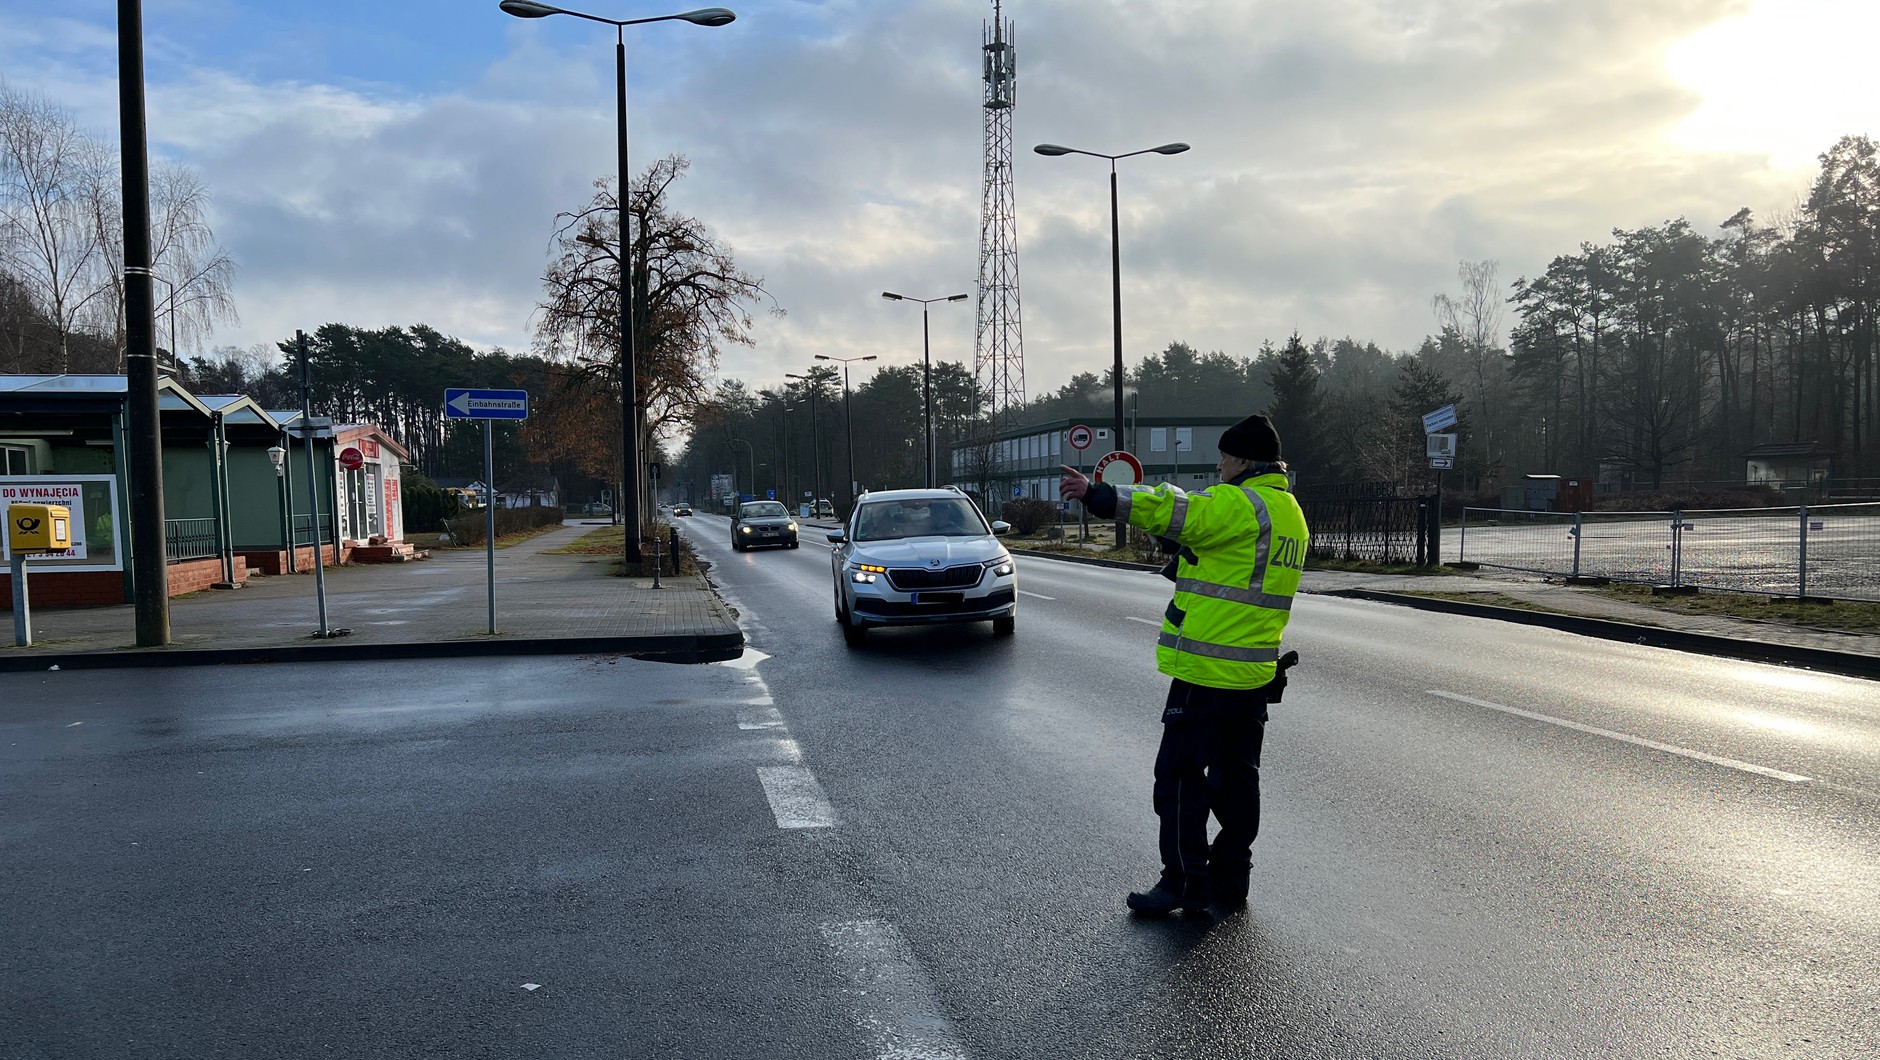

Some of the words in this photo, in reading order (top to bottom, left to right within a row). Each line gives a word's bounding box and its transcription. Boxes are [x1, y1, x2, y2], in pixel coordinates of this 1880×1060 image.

[467, 400, 521, 409] Einbahnstraße
[1096, 453, 1120, 474] HALT
[2, 488, 16, 498] DO
[19, 487, 79, 499] WYNAJĘCIA
[1360, 480, 1399, 498] AHLBECK
[1166, 707, 1184, 715] ZOLL
